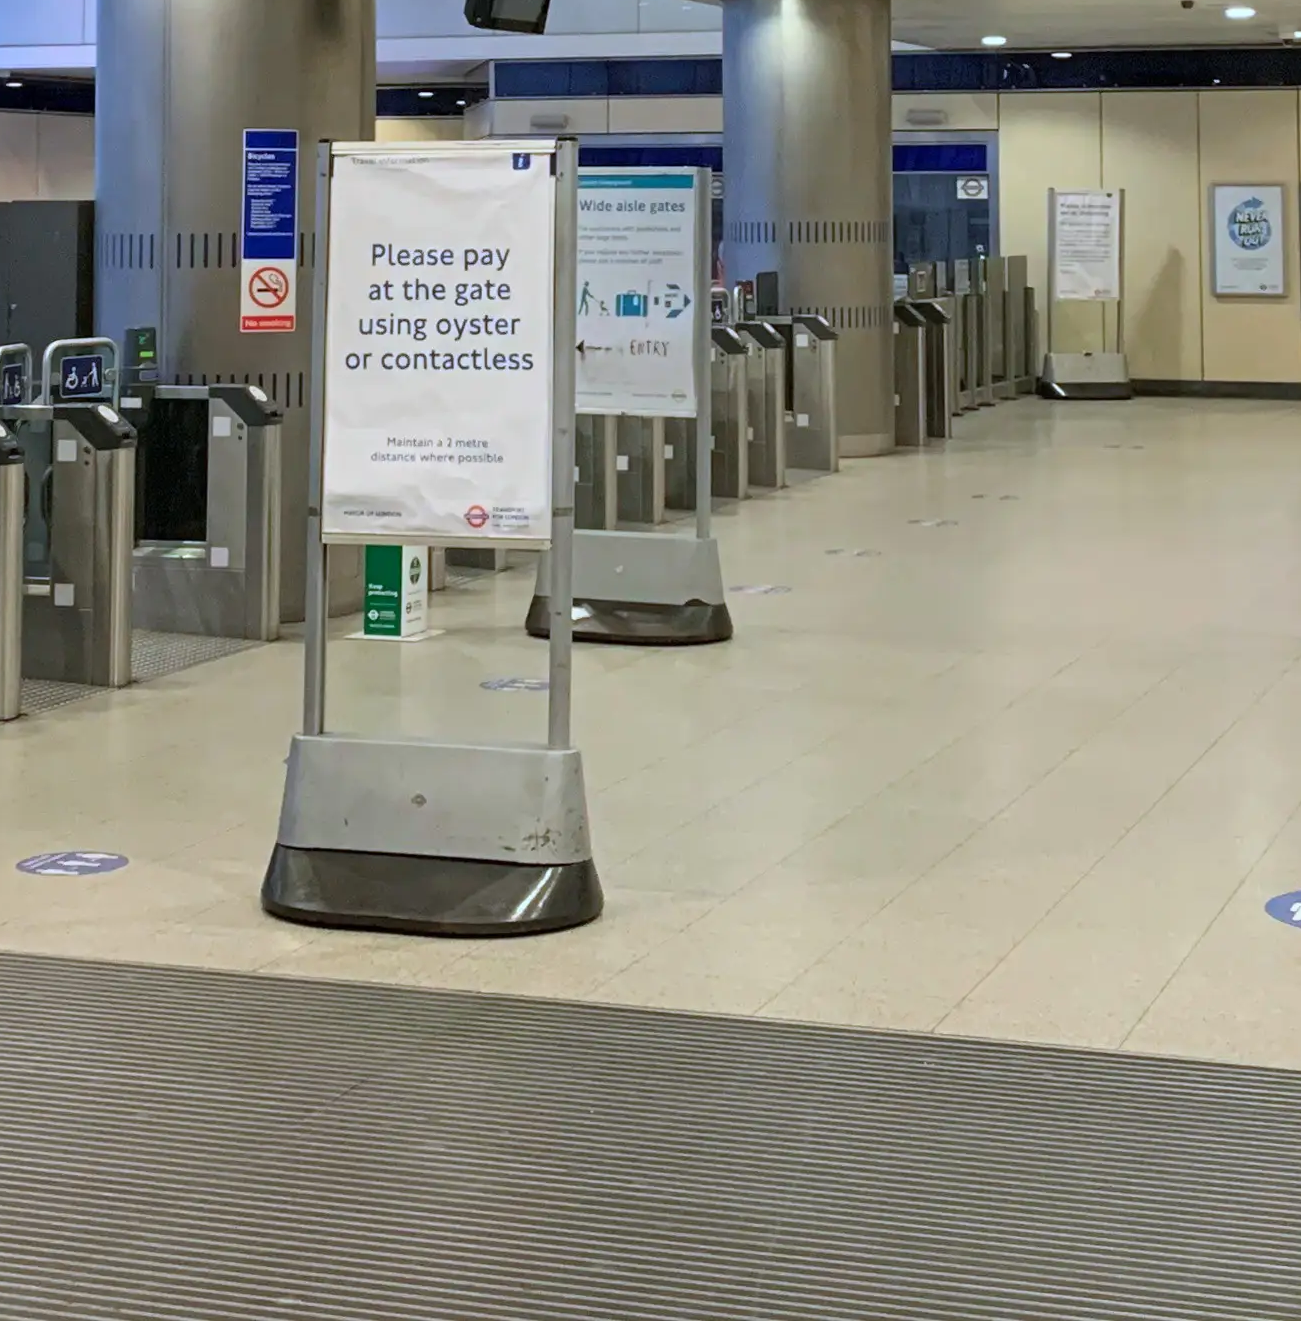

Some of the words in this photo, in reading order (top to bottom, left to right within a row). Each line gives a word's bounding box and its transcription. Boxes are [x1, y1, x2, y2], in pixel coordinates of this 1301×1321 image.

[579, 199, 612, 212] Wide
[616, 199, 645, 212] aisle
[650, 200, 686, 214] gates
[371, 244, 454, 266] Please
[464, 248, 510, 271] pay
[368, 280, 394, 300] at
[403, 278, 446, 300] the
[454, 280, 511, 306] gate
[245, 319, 257, 328] No
[358, 313, 427, 341] using
[436, 314, 521, 341] oyster
[630, 339, 670, 357] ENTRY
[345, 352, 372, 370] or
[381, 347, 534, 371] contactless
[387, 437, 433, 448] Maintain
[436, 440, 443, 448] a
[447, 438, 452, 448] 2
[455, 438, 489, 448] metre
[370, 452, 416, 463] distance
[419, 452, 454, 463] where
[458, 453, 504, 464] possible
